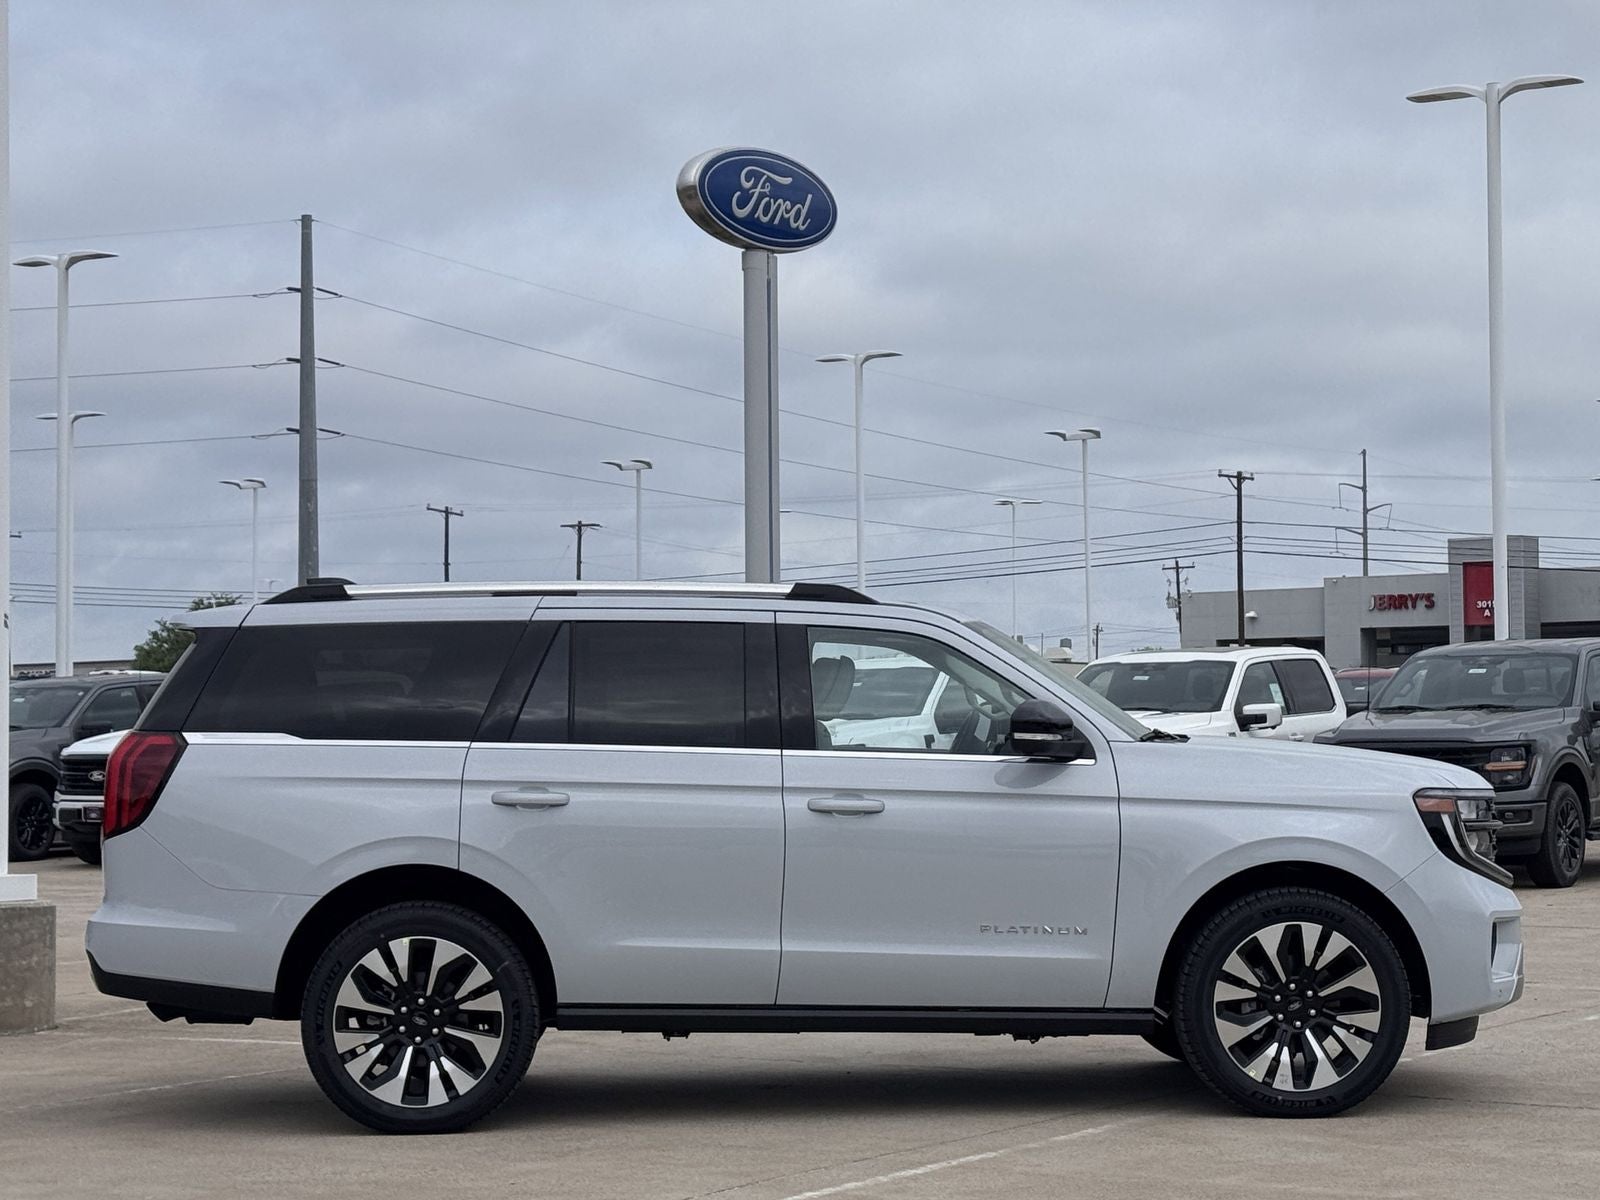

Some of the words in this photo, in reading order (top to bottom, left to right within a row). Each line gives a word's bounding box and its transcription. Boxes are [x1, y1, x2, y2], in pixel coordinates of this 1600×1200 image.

[731, 166, 812, 231] Ford
[1369, 593, 1435, 610] JERRY'S
[980, 925, 1088, 935] PLATINUM
